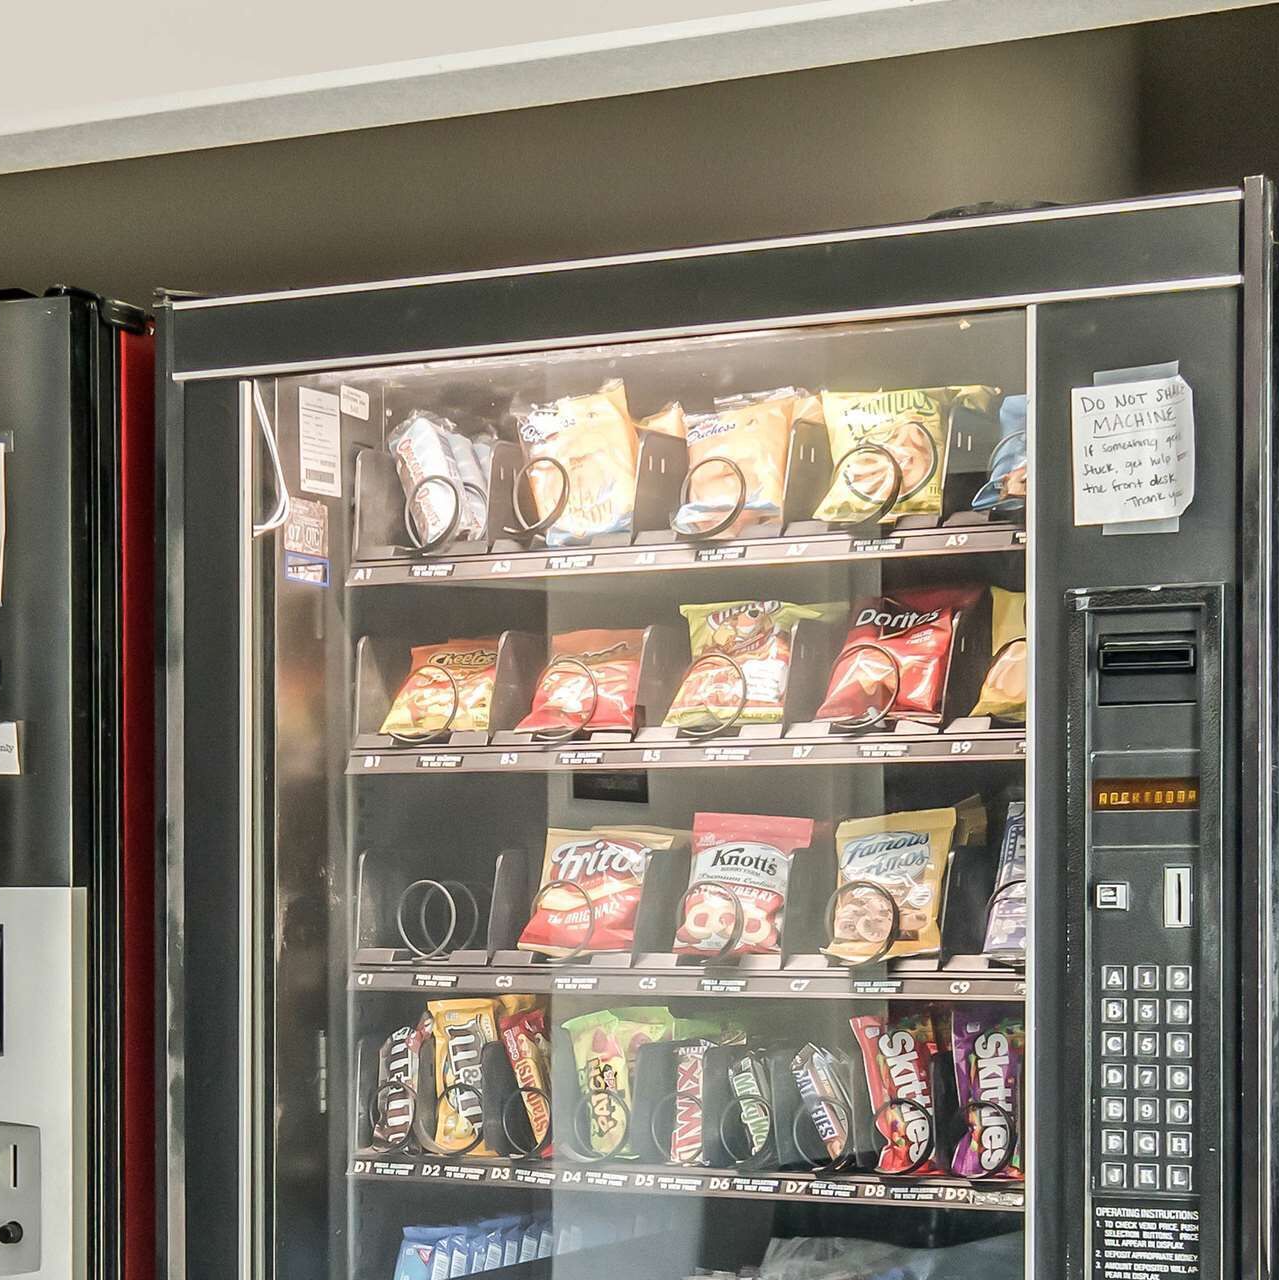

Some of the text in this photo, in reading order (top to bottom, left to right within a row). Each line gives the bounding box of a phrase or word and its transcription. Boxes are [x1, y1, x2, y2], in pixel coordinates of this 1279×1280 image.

[1081, 396, 1105, 413] DO
[1115, 393, 1147, 408] NOT
[1093, 407, 1177, 434] MACHINE
[687, 421, 737, 443] Duchess
[1084, 444, 1094, 457] If
[1125, 460, 1142, 475] get
[1151, 453, 1171, 466] help
[1083, 483, 1107, 494] the
[1112, 481, 1144, 491] front
[945, 534, 968, 547] A9
[354, 568, 372, 580] A1
[855, 607, 941, 628] Doritos
[429, 649, 498, 668] Cheetos
[792, 746, 814, 759] B7
[951, 741, 972, 754] B9
[363, 756, 381, 768] B1
[500, 753, 519, 765] B3
[642, 749, 662, 762] B5
[845, 833, 930, 866] Famous
[552, 837, 652, 877] Fritos
[711, 847, 778, 877] Knott's
[358, 974, 373, 985] C1
[495, 976, 513, 988] C3
[639, 977, 657, 989] C5
[1107, 971, 1122, 985] A
[1142, 971, 1151, 985] 1
[1174, 972, 1185, 986] 2
[790, 979, 810, 992] C7
[949, 981, 971, 993] C9
[1108, 1001, 1121, 1018] B
[1141, 1004, 1153, 1018] 3
[1173, 1005, 1185, 1019] 4
[1107, 1036, 1121, 1051] C
[1141, 1037, 1153, 1051] 5
[1174, 1039, 1185, 1052] 6
[1108, 1069, 1121, 1084] D
[1141, 1070, 1153, 1084] 7
[1173, 1072, 1185, 1085] 8
[877, 1029, 930, 1164] Skittles
[974, 1031, 1013, 1171] Skittles
[671, 1057, 703, 1161] TWIX
[1108, 1102, 1122, 1117] E
[1142, 1104, 1152, 1117] 9
[1174, 1105, 1185, 1119] 0
[1108, 1135, 1121, 1149] F
[1140, 1136, 1154, 1151] G
[1172, 1137, 1187, 1151] H
[354, 1161, 372, 1173] D1
[422, 1165, 440, 1177] D2
[491, 1168, 511, 1181] D3
[562, 1171, 582, 1183] D4
[635, 1174, 655, 1187] D5
[1109, 1168, 1121, 1182] J
[1140, 1169, 1155, 1184] K
[1173, 1171, 1186, 1185] L
[709, 1177, 730, 1190] D6
[785, 1181, 807, 1193] D7
[865, 1184, 885, 1197] D8
[945, 1188, 966, 1201] D9
[1096, 1206, 1199, 1220] OPERATING INSTRUCTIONS
[1104, 1220, 1113, 1228] TO
[1115, 1221, 1138, 1230] CHECK
[1138, 1222, 1157, 1230] VEND
[1104, 1230, 1199, 1241] SELECTION PRICE
[1104, 1239, 1120, 1247] WILL
[1121, 1240, 1147, 1248] APPEAR
[1104, 1250, 1175, 1261] DEPOSIT APPROPRIATE
[1104, 1262, 1186, 1273] AMOUNT DEPOSITED WILL
